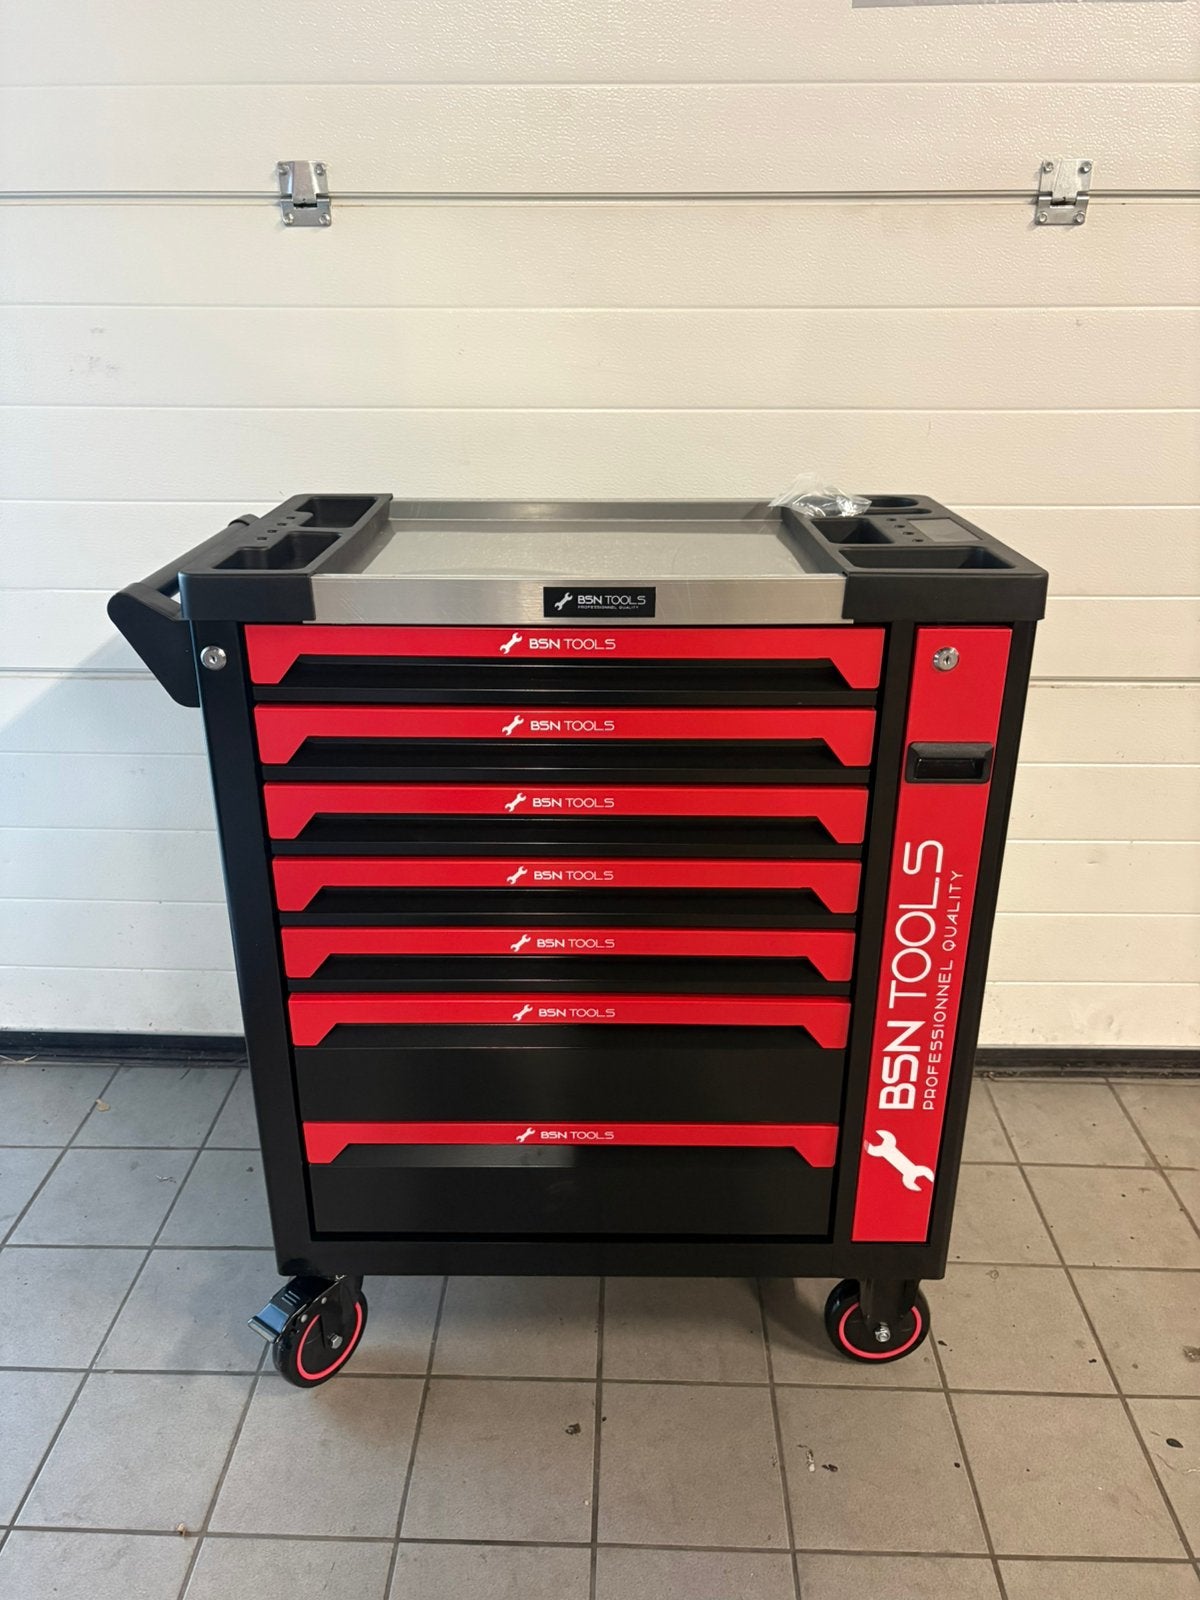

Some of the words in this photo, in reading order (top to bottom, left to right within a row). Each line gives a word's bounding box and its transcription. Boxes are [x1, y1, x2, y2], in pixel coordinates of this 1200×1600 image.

[577, 595, 603, 605] BSN
[604, 595, 646, 606] TOOLS
[529, 638, 560, 650] BSN
[563, 638, 616, 650] TOOLS
[530, 720, 561, 731] BSN
[563, 720, 615, 731] TOOLS
[532, 797, 562, 808] BSN
[565, 797, 614, 808] TOOLS
[533, 870, 563, 881] BSN
[566, 870, 614, 881] TOOLS
[889, 840, 944, 1009] TOOLS
[536, 938, 566, 948] BSN
[568, 938, 615, 948] TOOLS
[922, 959, 954, 1110] PROFESSIONNEL
[942, 870, 964, 952] QUALITY
[538, 1008, 567, 1018] BSN
[569, 1008, 615, 1018] TOOLS
[878, 1020, 926, 1110] BSN
[540, 1131, 568, 1140] BSN
[570, 1131, 614, 1140] TOOLS
